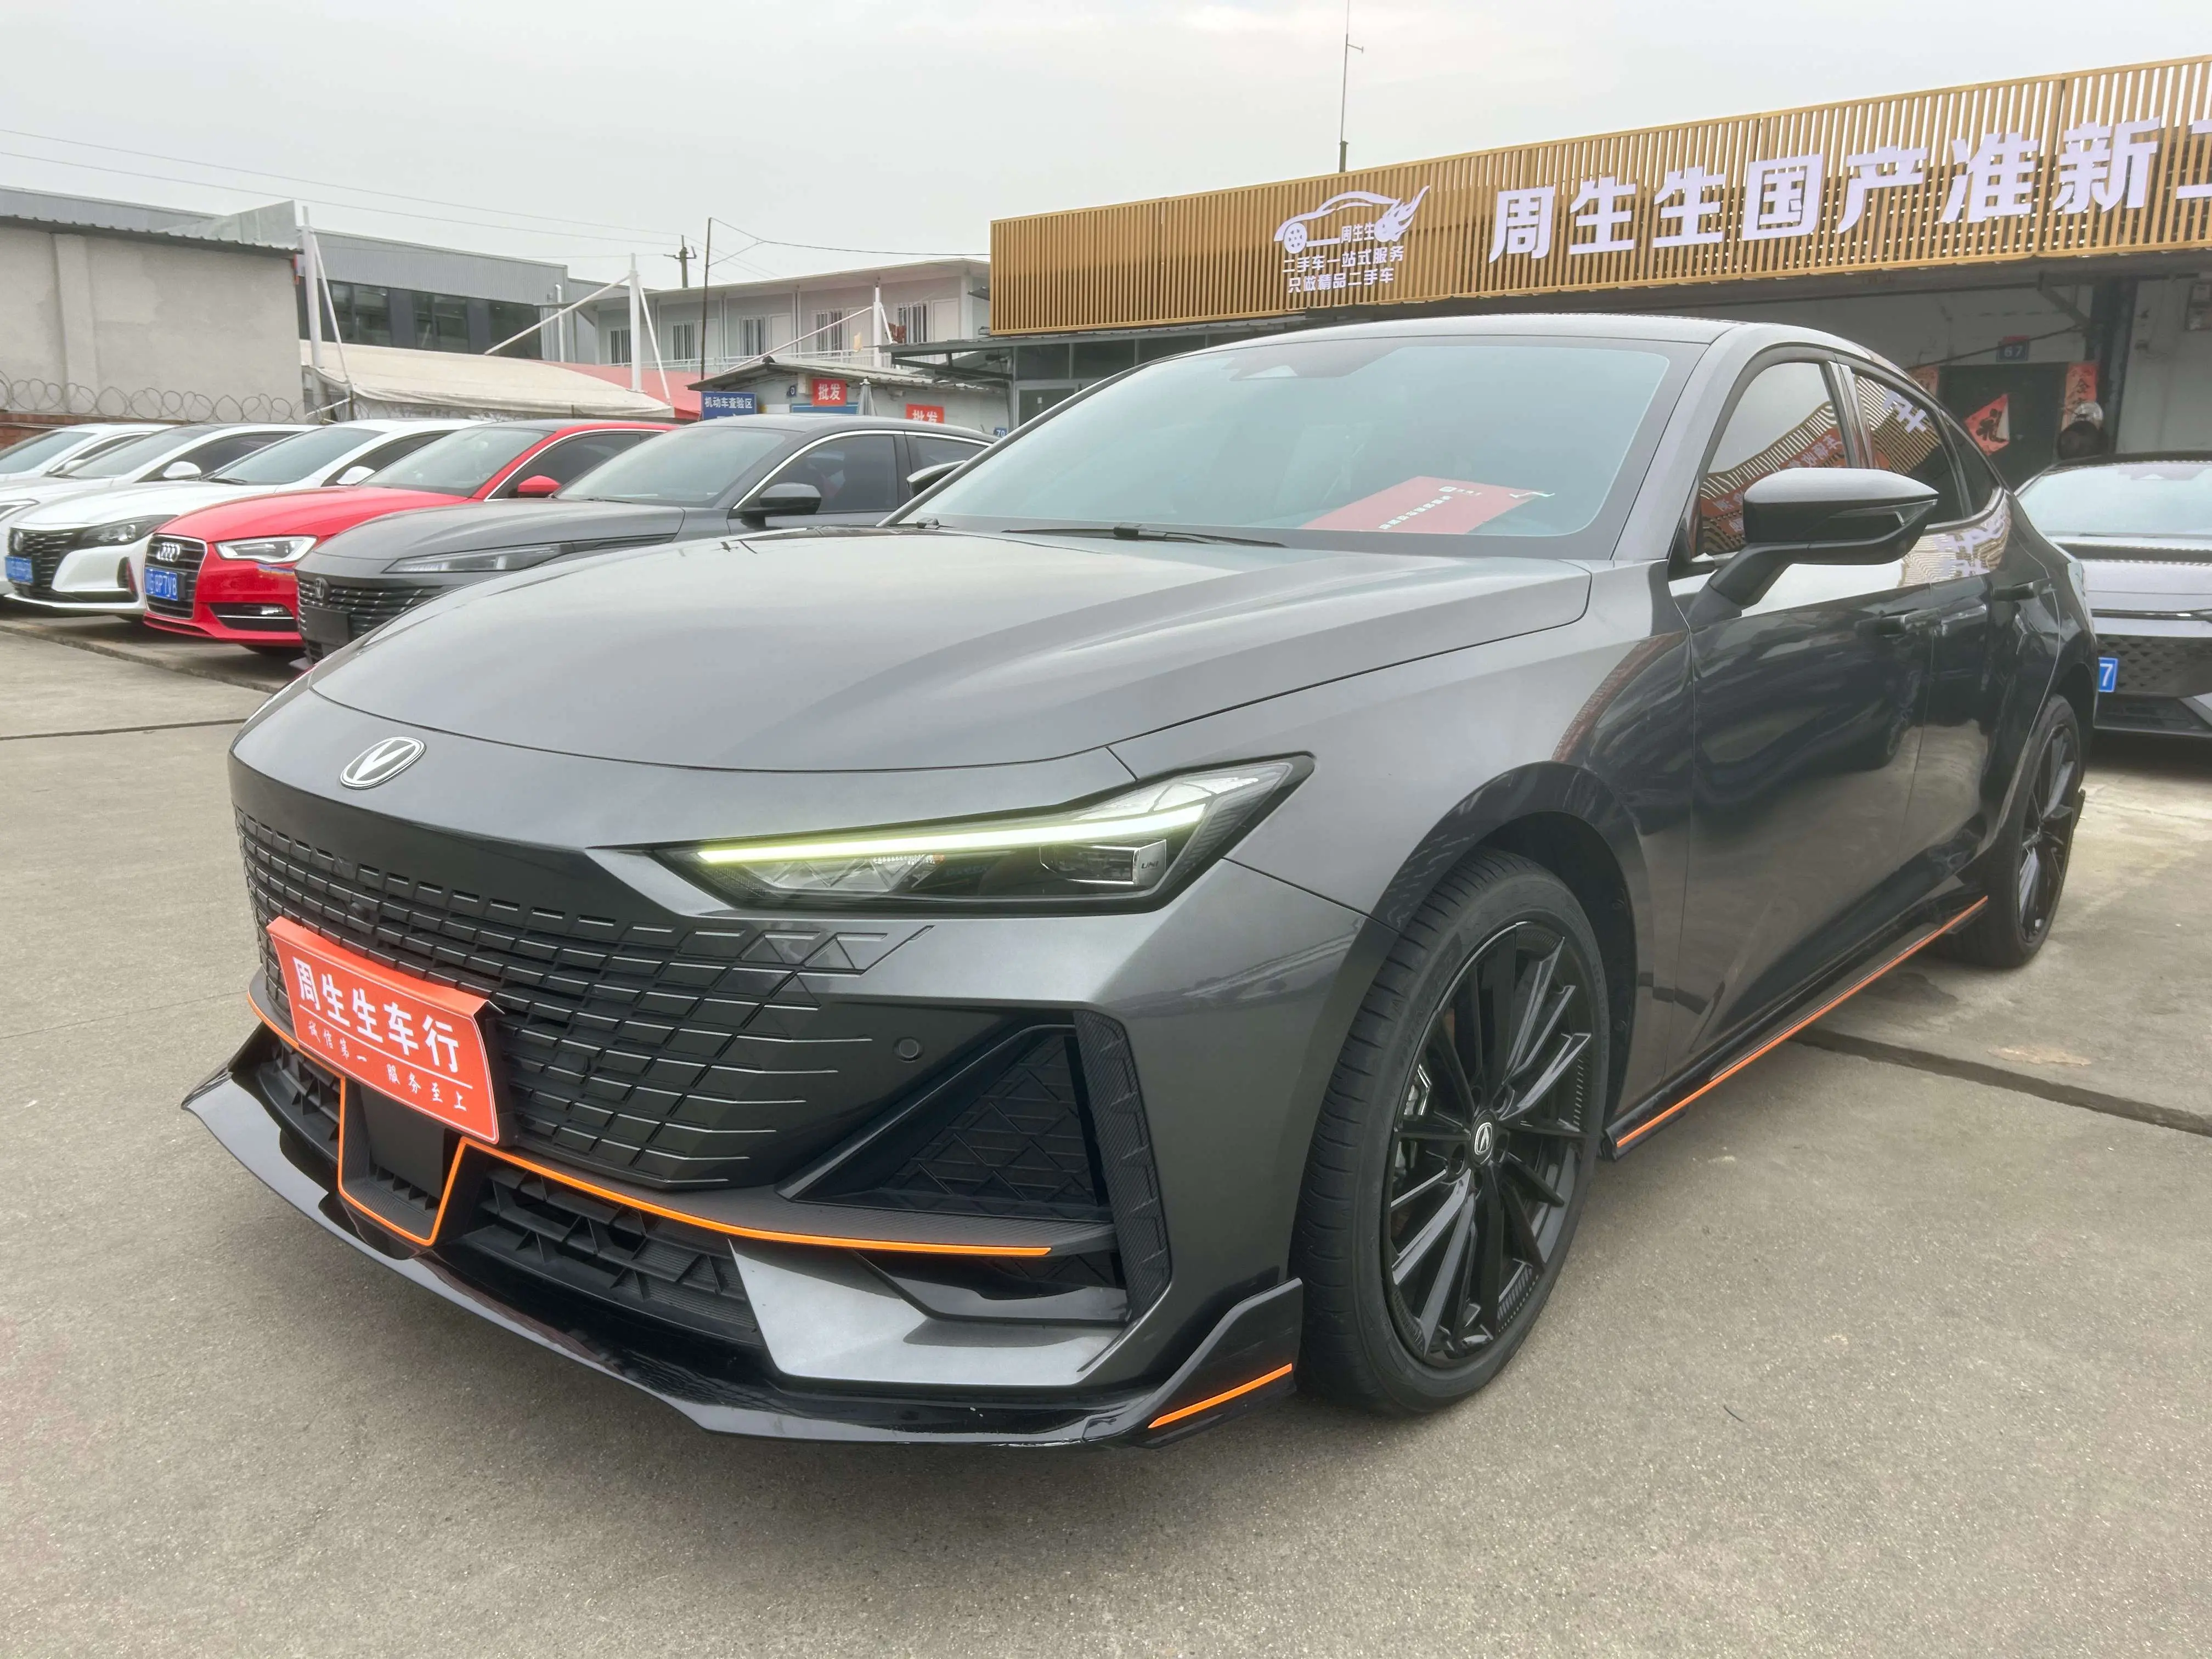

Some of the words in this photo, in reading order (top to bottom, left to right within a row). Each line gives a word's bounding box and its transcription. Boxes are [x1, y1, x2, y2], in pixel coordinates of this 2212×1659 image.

[1341, 222, 1374, 244] 周生生
[1282, 245, 1404, 273] 二手车一站式服务
[1289, 267, 1394, 293] 只做精品二手车
[2004, 346, 2023, 357] 67
[704, 397, 753, 409] 机动车查验区
[818, 383, 841, 400] 批发
[293, 956, 459, 1073] 周生生车行
[386, 1063, 467, 1111] 服务至上
